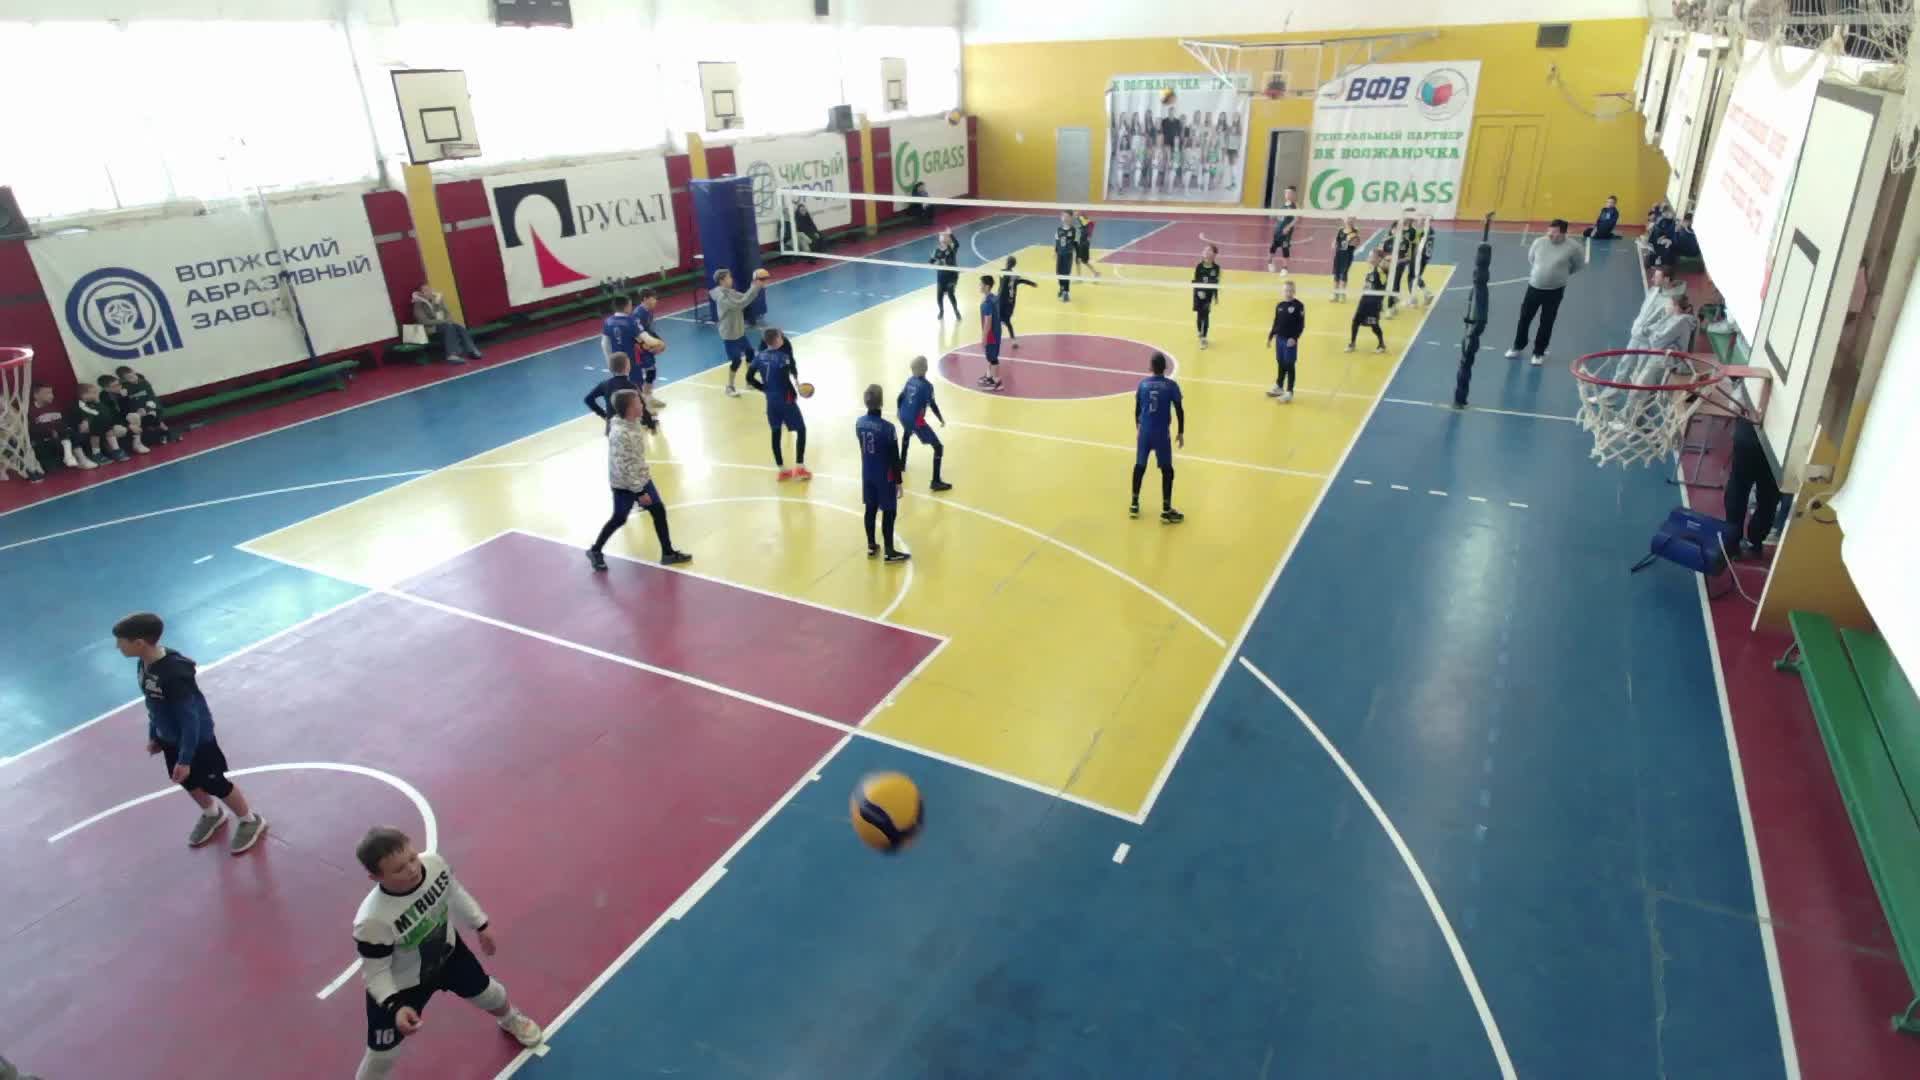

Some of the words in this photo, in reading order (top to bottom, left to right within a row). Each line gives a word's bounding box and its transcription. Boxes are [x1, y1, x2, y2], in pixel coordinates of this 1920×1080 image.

[1345, 76, 1411, 101] ВФВ
[1315, 131, 1402, 141] ГЕНЕРАЛЬНЫЙ
[1406, 130, 1465, 140] ПАРТНЕР
[778, 151, 844, 182] ЧИСТЫЙ
[923, 144, 965, 174] GRASS
[1340, 146, 1460, 160] ВОЛЖАНОЧКА
[1361, 179, 1454, 204] GRASS
[576, 193, 667, 234] РУСАЛ
[175, 236, 340, 282] ВОЛЖСКИЙ
